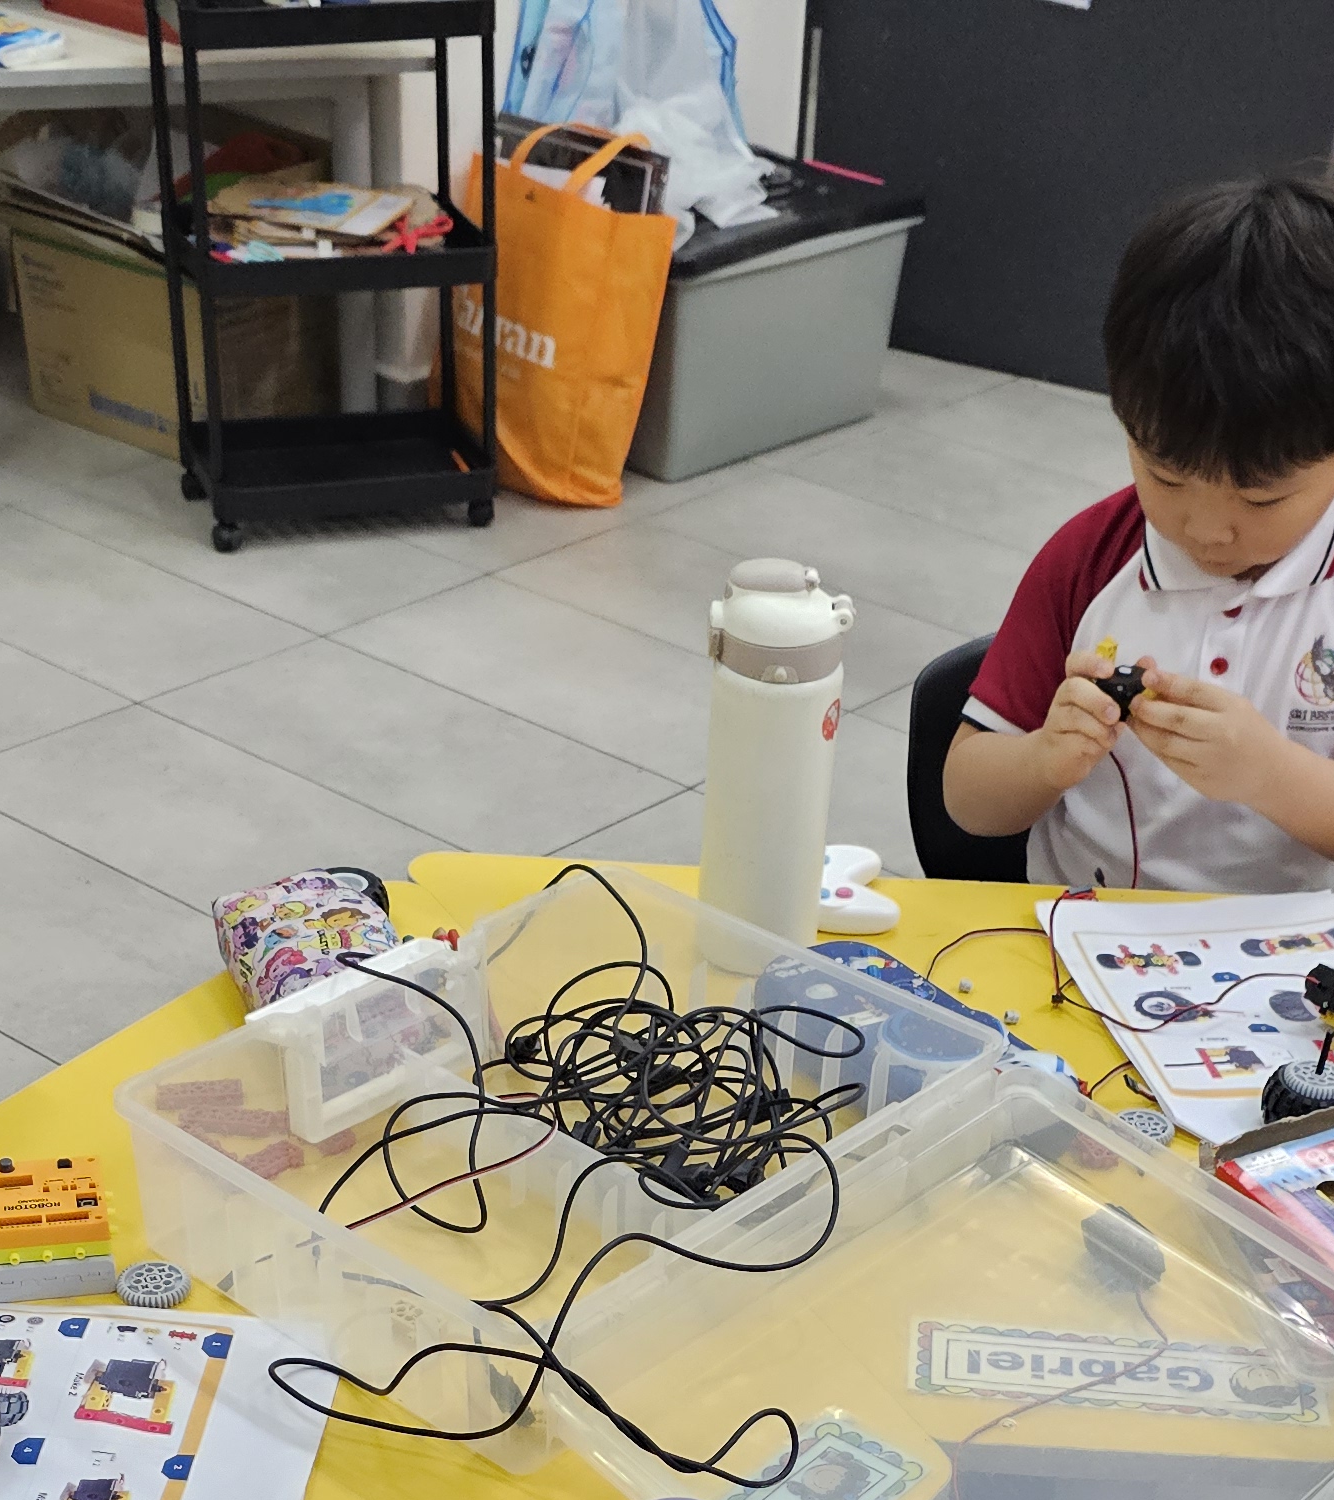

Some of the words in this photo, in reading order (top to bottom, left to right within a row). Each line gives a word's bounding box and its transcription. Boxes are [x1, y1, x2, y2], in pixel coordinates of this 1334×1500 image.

[3, 1201, 61, 1211] ROBOTORI
[71, 1371, 85, 1391] Make
[967, 1349, 1215, 1393] Gabriel
